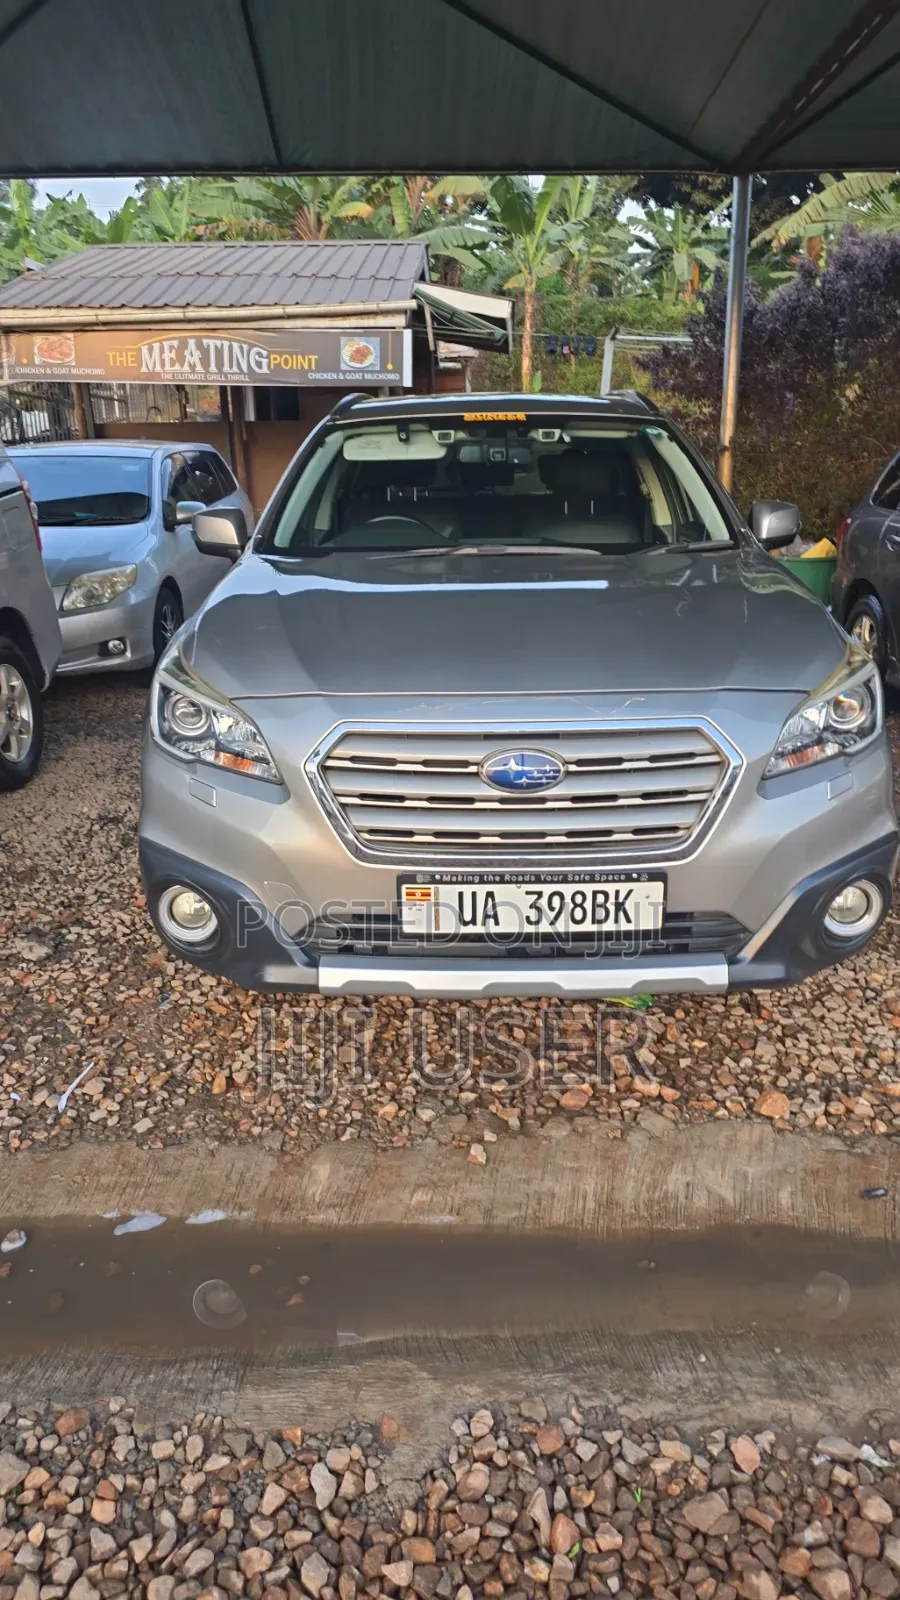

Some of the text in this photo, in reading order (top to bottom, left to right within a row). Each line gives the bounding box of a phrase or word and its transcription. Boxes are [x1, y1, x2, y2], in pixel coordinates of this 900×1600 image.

[106, 338, 318, 374] THE MEATING POINT
[345, 372, 363, 380] GOAT
[442, 874, 480, 883] Making
[483, 874, 500, 882] the
[504, 874, 535, 882] Roads
[567, 873, 590, 881] Safe
[594, 873, 625, 882] Space
[457, 889, 634, 927] UA 398BK
